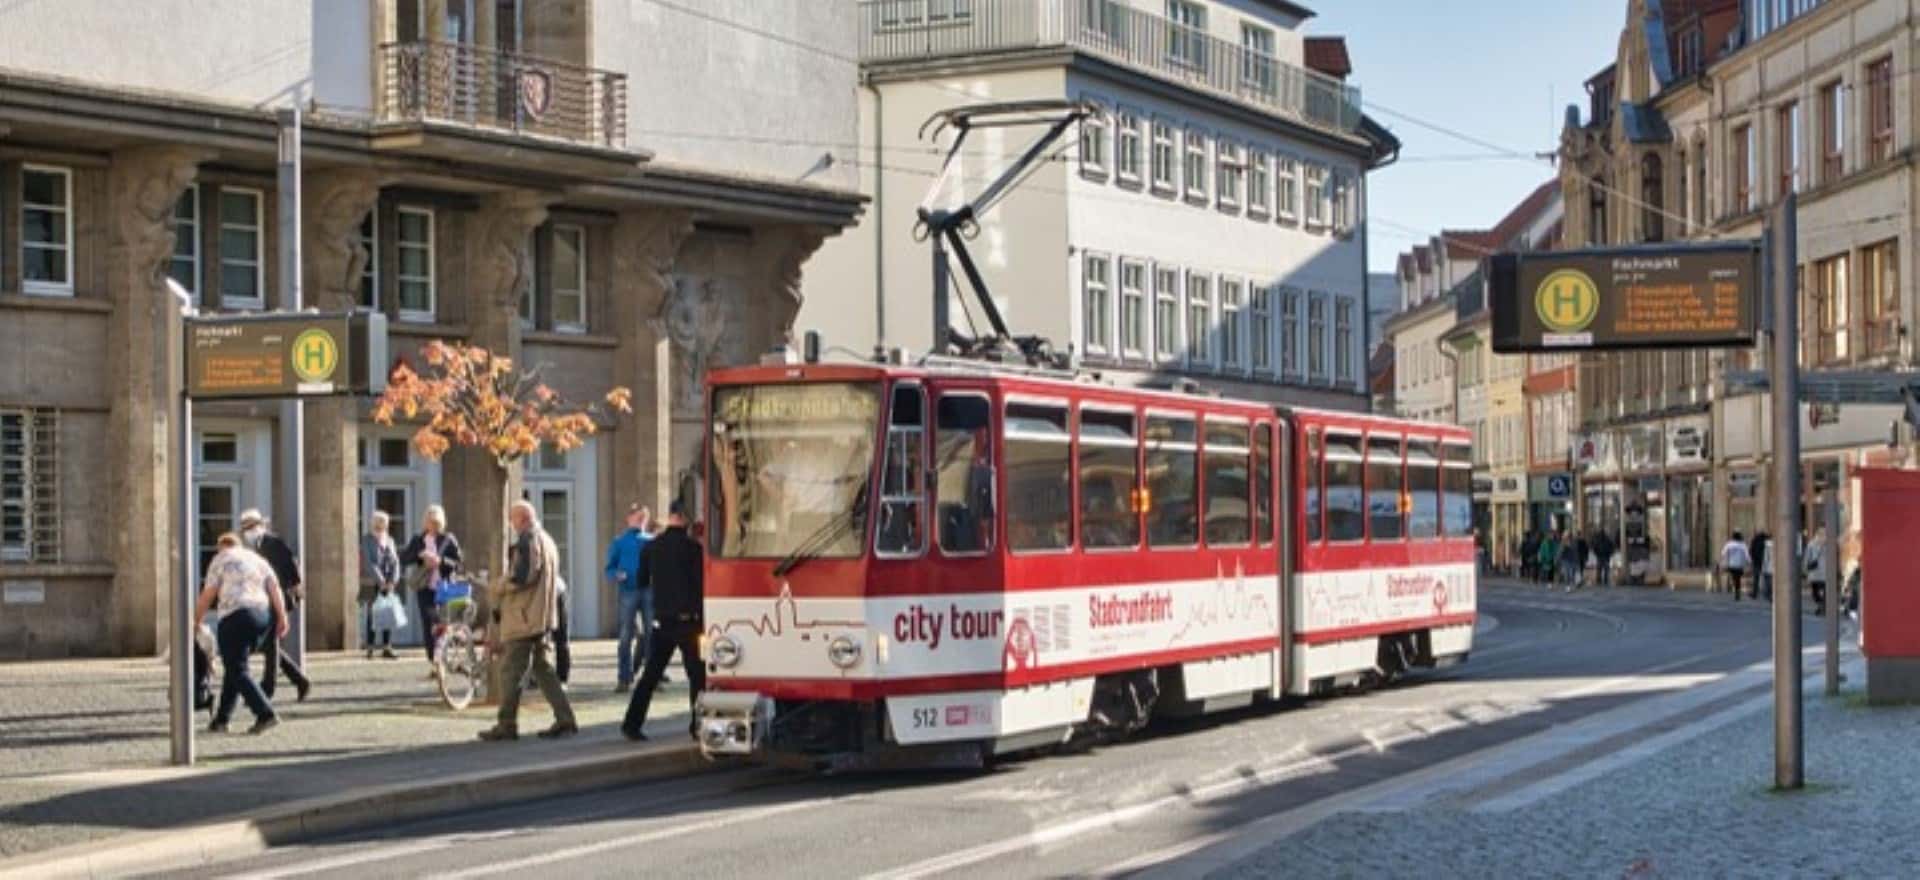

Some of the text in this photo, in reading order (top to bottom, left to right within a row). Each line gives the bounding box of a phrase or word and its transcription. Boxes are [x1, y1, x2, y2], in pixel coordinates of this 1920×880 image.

[1553, 285, 1580, 317] H
[305, 341, 324, 369] H
[894, 606, 944, 648] city
[950, 603, 1003, 640] tour
[912, 708, 938, 728] 512
